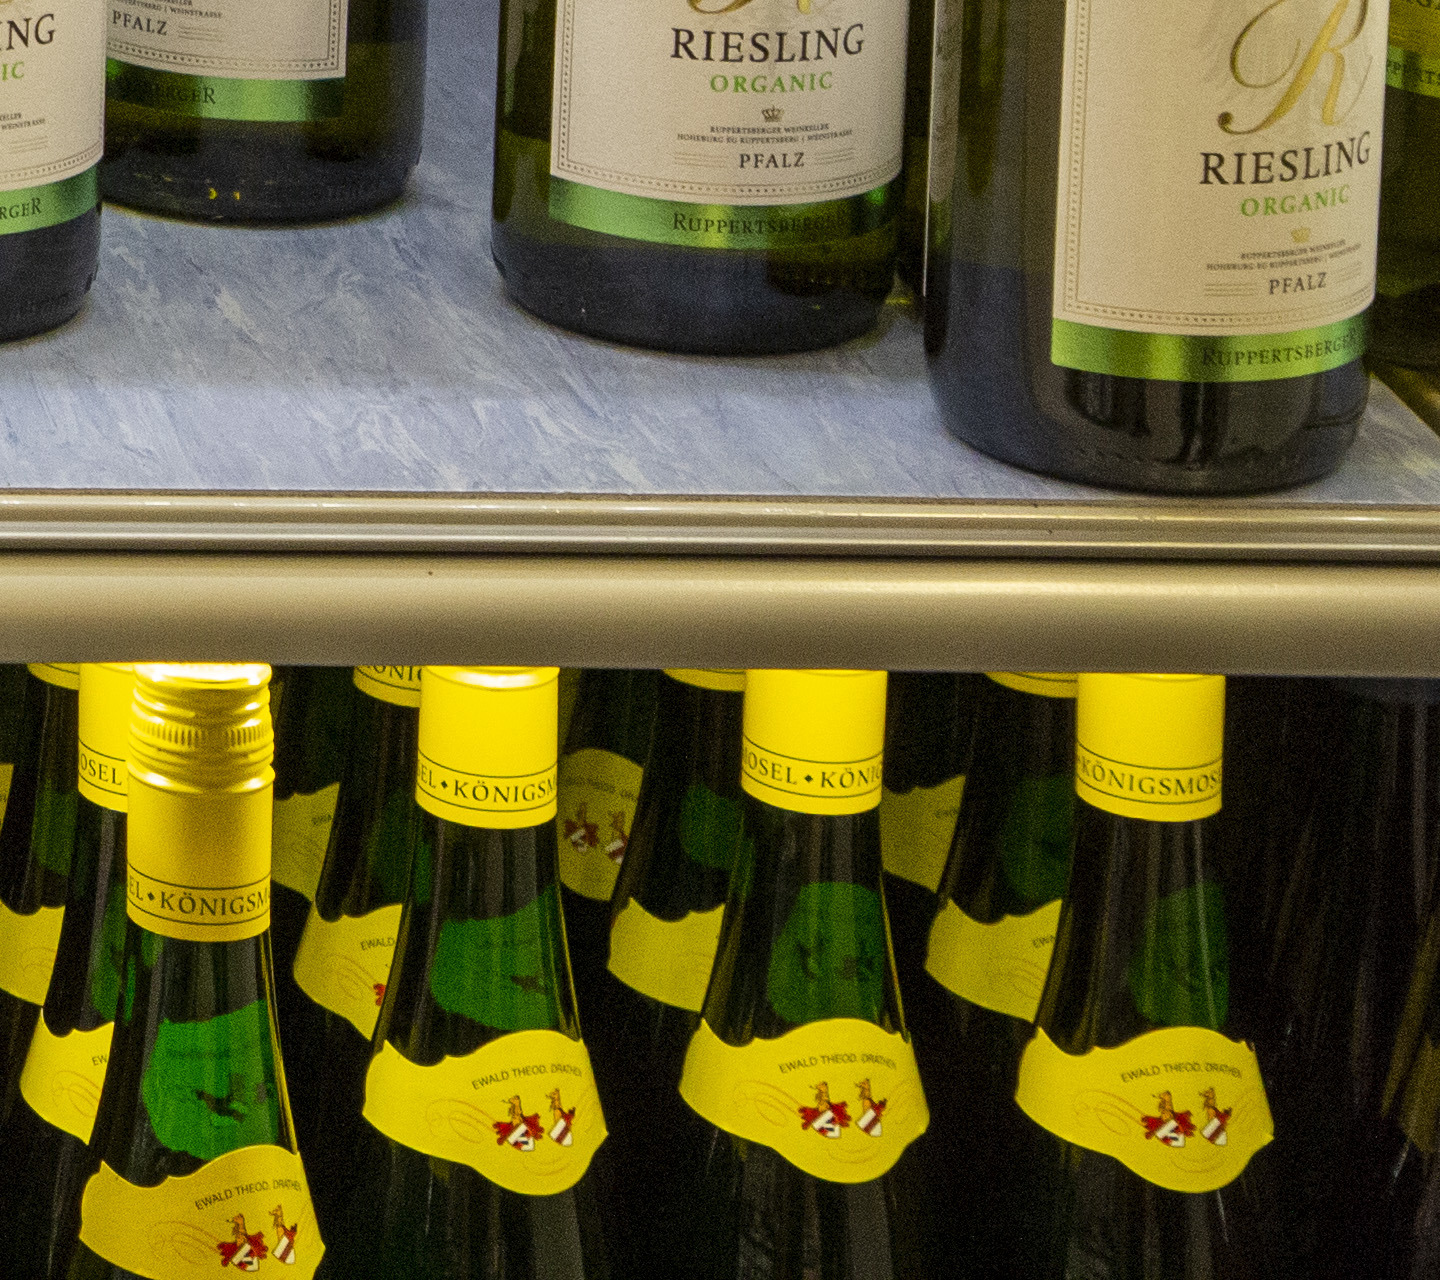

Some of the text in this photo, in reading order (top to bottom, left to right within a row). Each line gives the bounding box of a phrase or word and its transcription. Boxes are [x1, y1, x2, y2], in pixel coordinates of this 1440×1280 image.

[670, 23, 865, 64] RIESLING
[710, 72, 834, 94] ORGANIC
[739, 151, 805, 170] PFALZ
[1199, 131, 1371, 186] RIESLING
[1241, 184, 1350, 217] ORGANIC
[1269, 272, 1327, 295] PFALZ
[1121, 1065, 1161, 1082] EWALD
